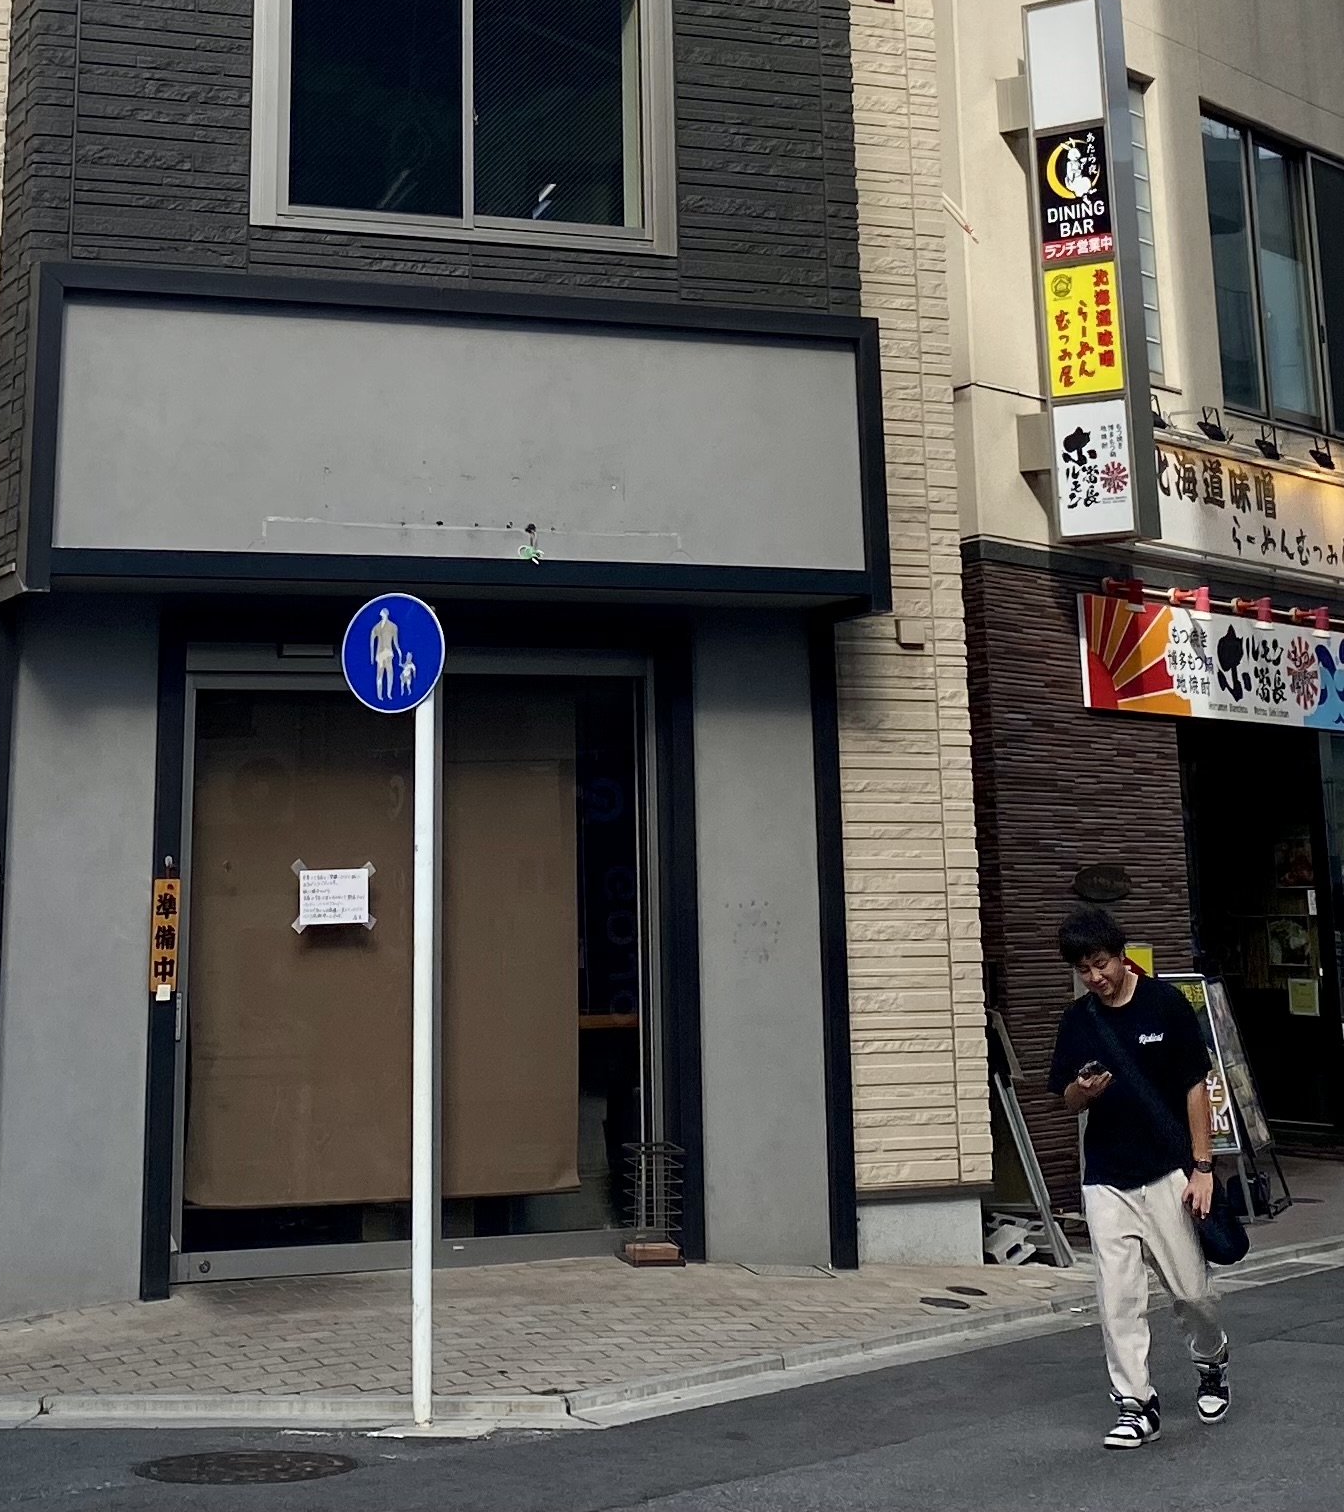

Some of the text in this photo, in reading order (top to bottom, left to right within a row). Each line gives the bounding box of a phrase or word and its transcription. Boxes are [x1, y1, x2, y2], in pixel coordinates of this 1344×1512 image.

[1047, 200, 1105, 223] DINING
[1060, 219, 1094, 237] BAR
[1045, 236, 1113, 259] ランチ営業中
[1076, 300, 1095, 377] らーめん
[154, 892, 178, 983] 準備中
